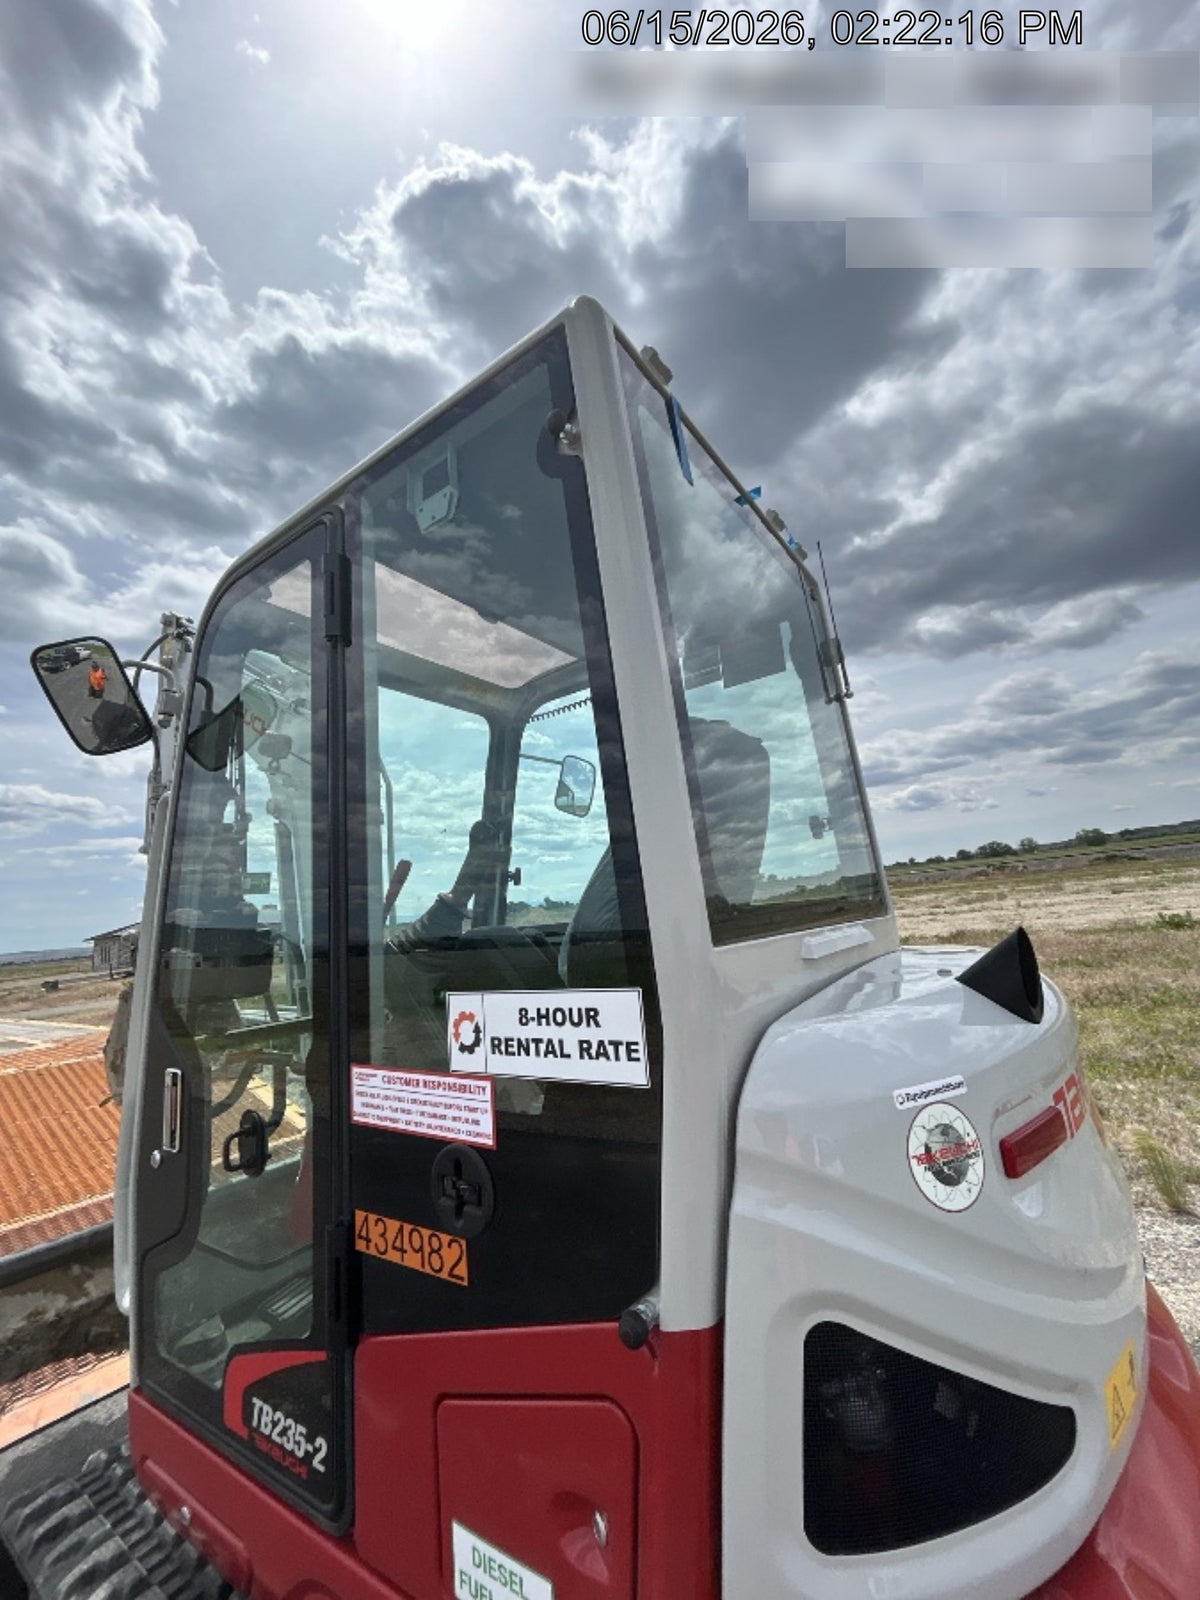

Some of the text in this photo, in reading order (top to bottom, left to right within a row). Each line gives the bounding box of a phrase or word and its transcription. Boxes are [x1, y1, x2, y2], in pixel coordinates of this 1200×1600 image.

[518, 1007, 602, 1028] 8-HOUR
[490, 1036, 641, 1062] RENTAL RATE
[382, 1075, 420, 1089] CUSTOMER
[422, 1079, 487, 1096] RESPONSIBILITY
[357, 1213, 466, 1283] 434982
[251, 1397, 328, 1473] TB235-2
[472, 1546, 529, 1600] DIESEL
